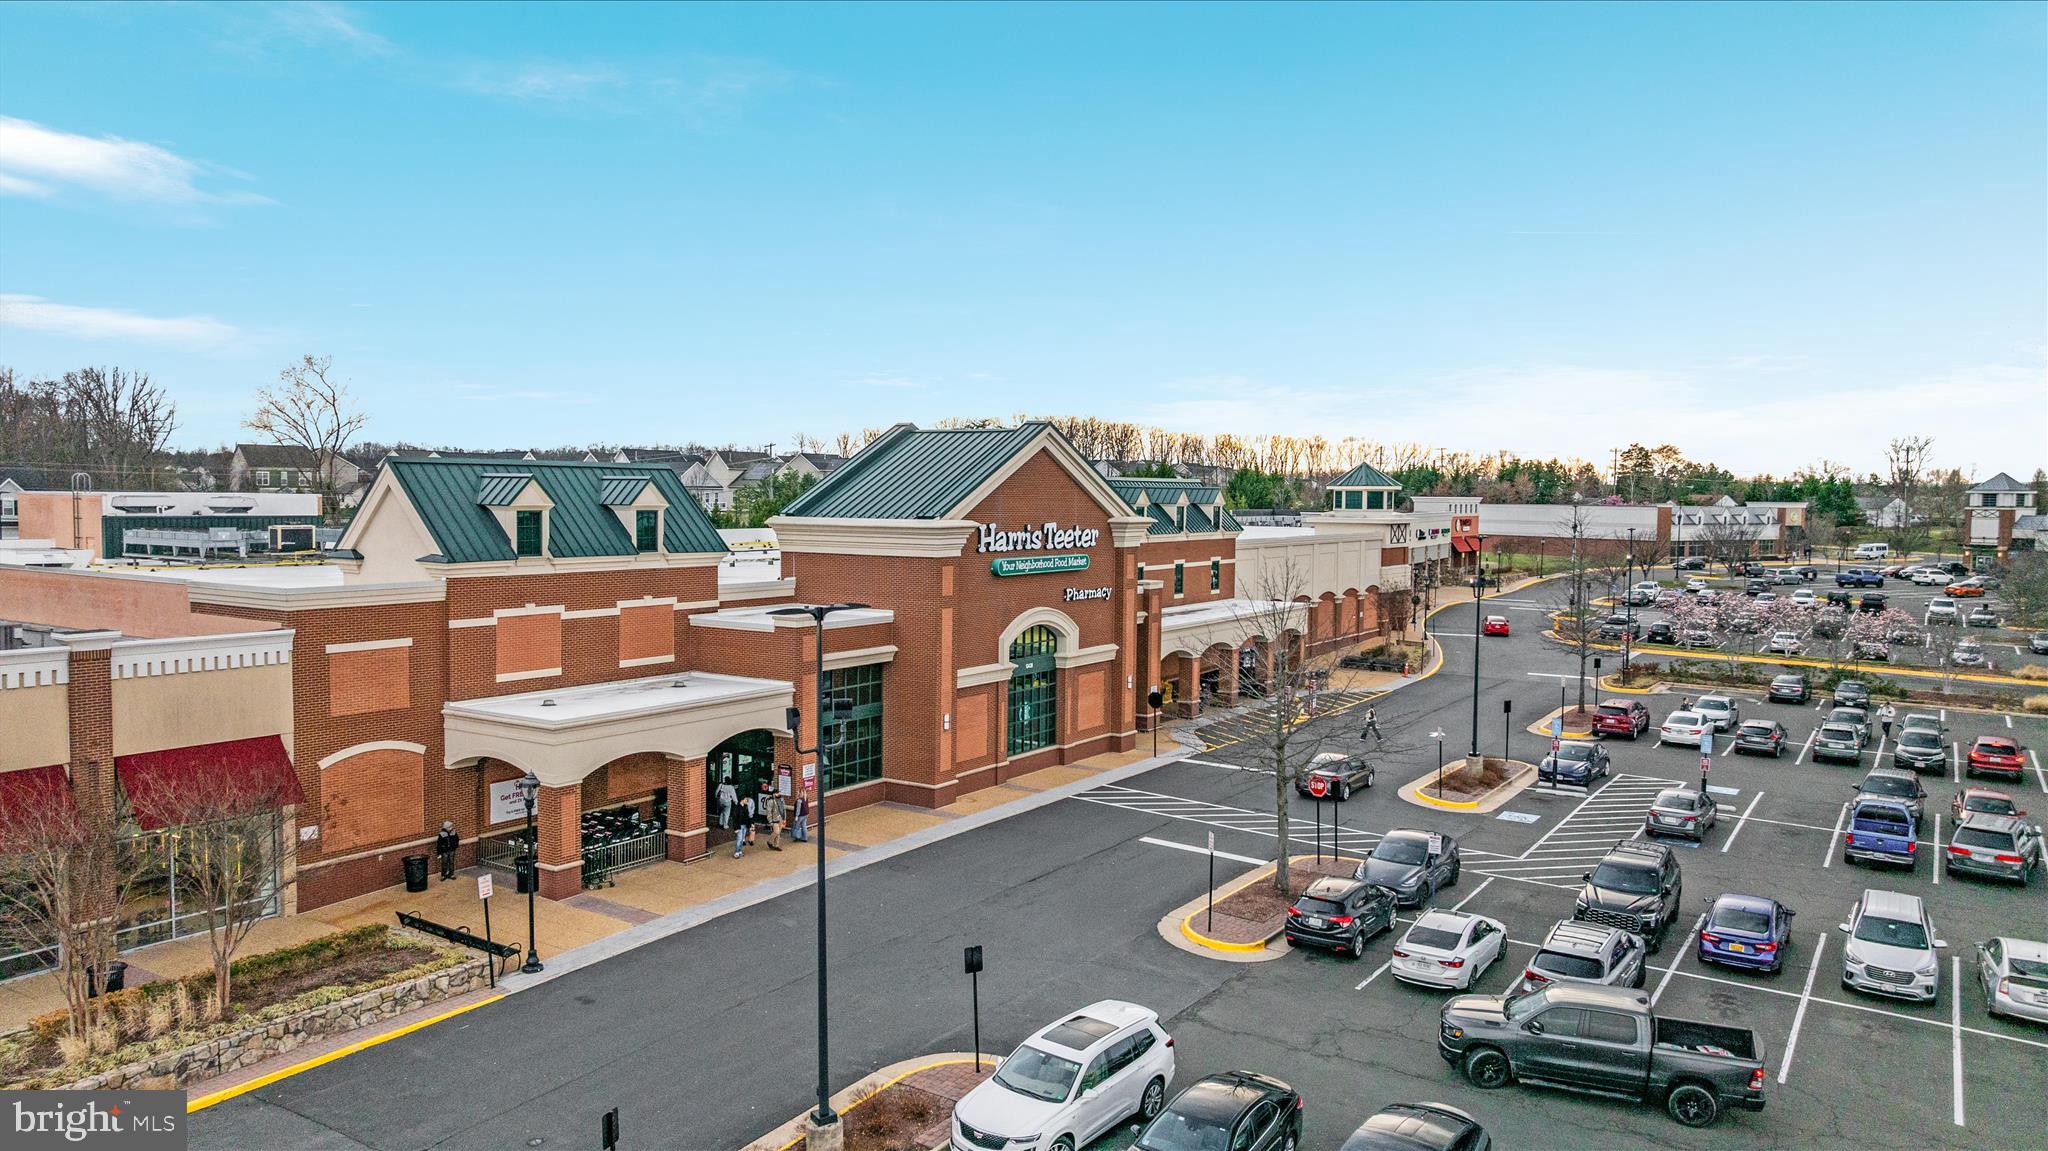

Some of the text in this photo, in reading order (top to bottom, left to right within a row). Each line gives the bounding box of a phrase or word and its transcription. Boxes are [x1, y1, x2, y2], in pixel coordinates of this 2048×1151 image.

[977, 521, 1099, 553] Harris Teeter
[1001, 556, 1087, 573] Your Neighborhood Food Market
[1065, 586, 1112, 601] Pharmacy
[1311, 781, 1324, 789] STOP
